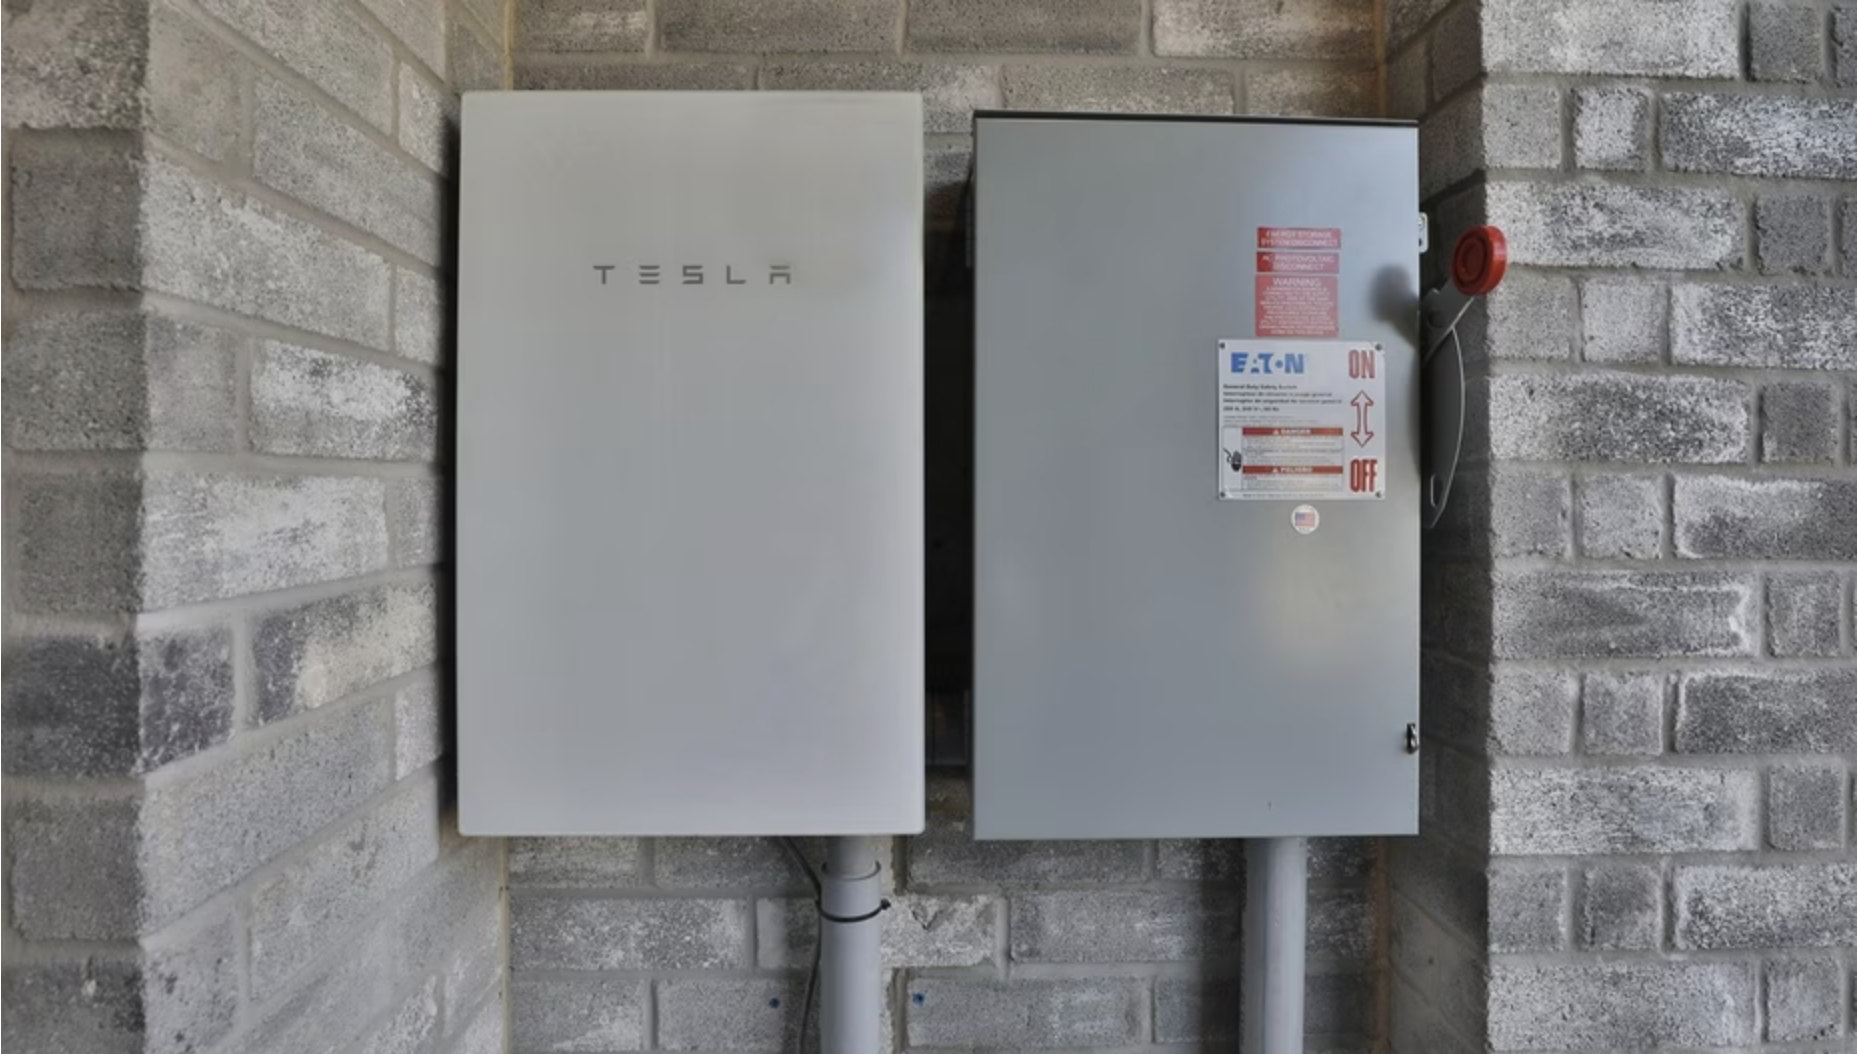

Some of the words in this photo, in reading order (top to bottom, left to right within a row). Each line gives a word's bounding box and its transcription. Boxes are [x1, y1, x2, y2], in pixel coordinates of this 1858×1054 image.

[592, 265, 791, 285] TESLA
[1273, 277, 1322, 286] WARNING
[1230, 352, 1305, 374] EATON
[1348, 349, 1376, 379] ON
[1280, 466, 1313, 474] PELIGRO
[1350, 459, 1378, 492] OFF
